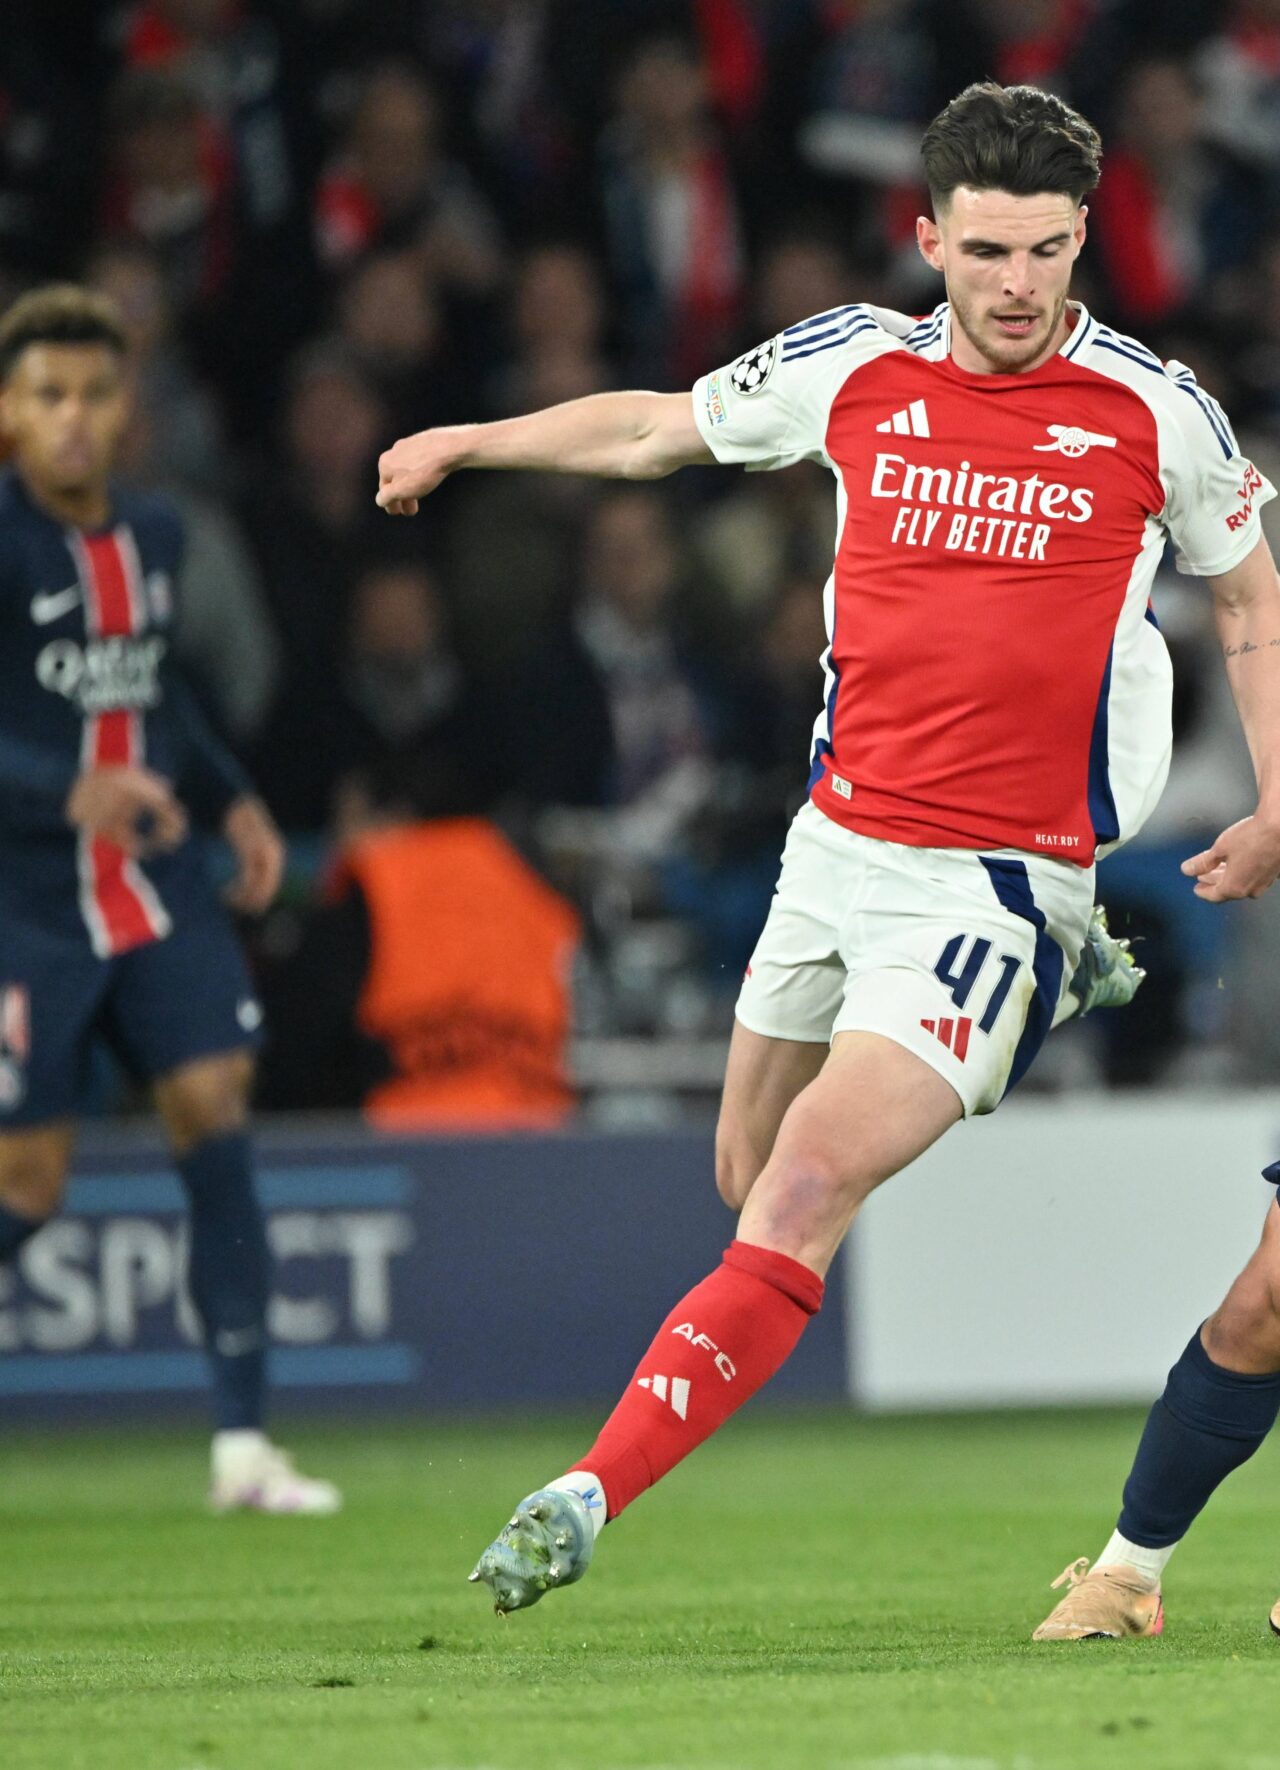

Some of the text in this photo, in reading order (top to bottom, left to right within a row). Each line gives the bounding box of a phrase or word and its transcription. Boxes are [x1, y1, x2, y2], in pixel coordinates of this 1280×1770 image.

[871, 453, 1094, 523] Emirates
[891, 506, 1051, 561] FLY BETTER
[931, 932, 1024, 1038] 41
[671, 1322, 737, 1382] AFC
